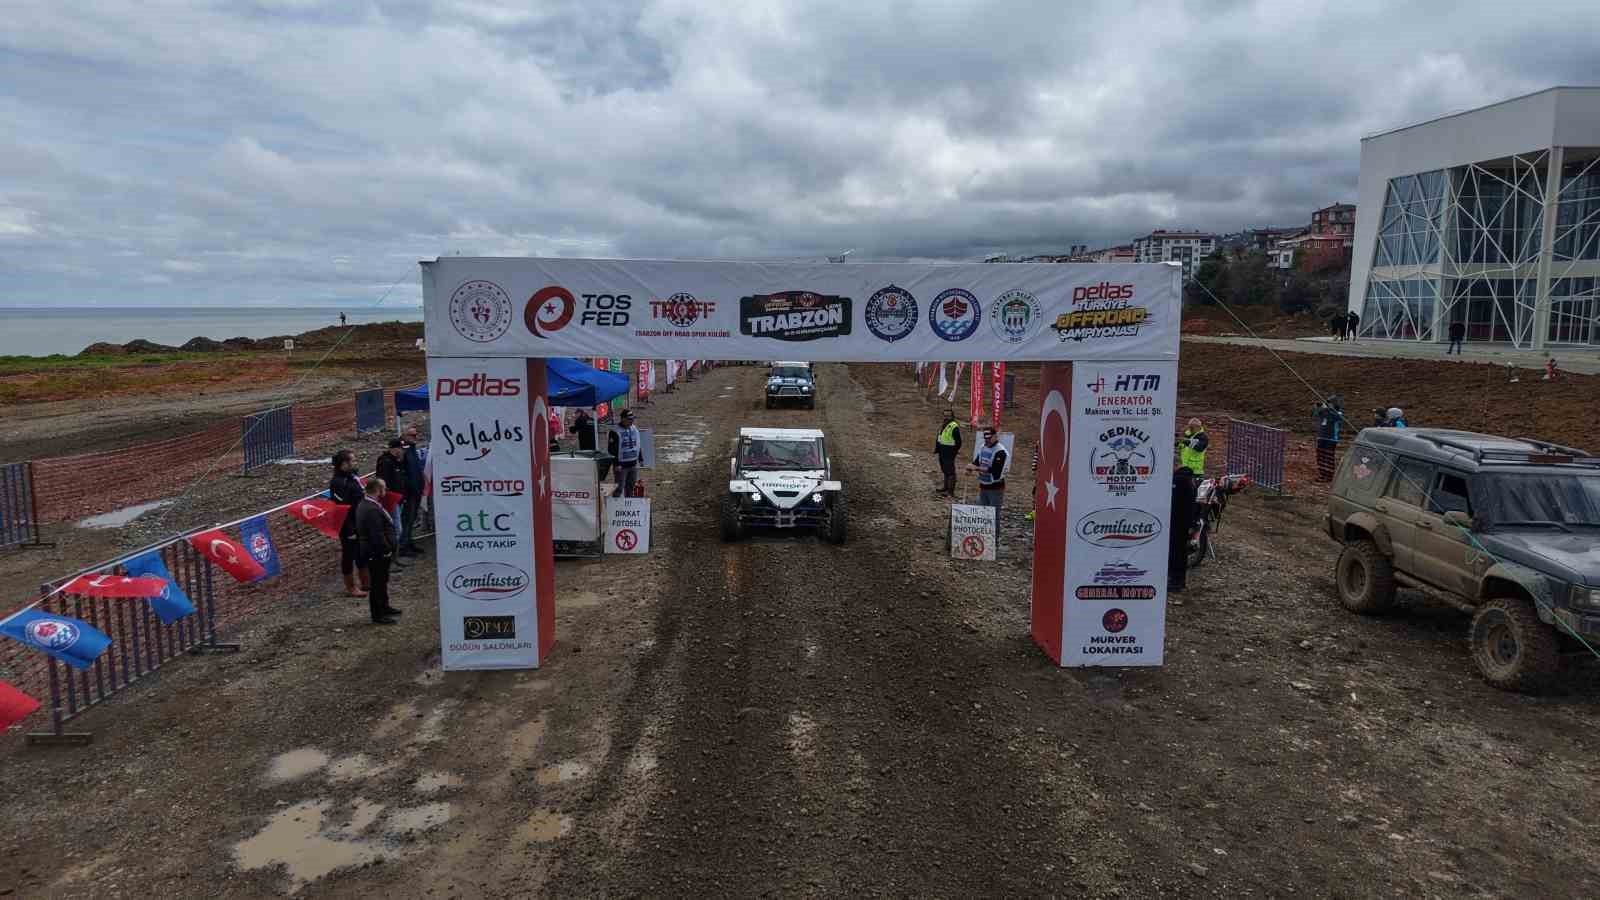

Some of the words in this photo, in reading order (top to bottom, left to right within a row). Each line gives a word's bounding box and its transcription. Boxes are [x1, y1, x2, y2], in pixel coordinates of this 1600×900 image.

[1072, 281, 1134, 305] petlas
[581, 294, 632, 310] TOS
[579, 311, 630, 327] FED
[748, 306, 843, 334] TRABZON
[435, 373, 521, 401] petlas
[1097, 395, 1153, 406] JENERATÖR
[1085, 408, 1110, 416] Makine
[441, 419, 524, 456] Salados
[456, 510, 512, 532] atc
[1082, 519, 1155, 536] Cemilusta
[455, 541, 485, 551] ARAÇ
[487, 539, 517, 549] TAKİP
[452, 572, 522, 590] Cemilusta
[1082, 646, 1144, 655] LOKANTASI
